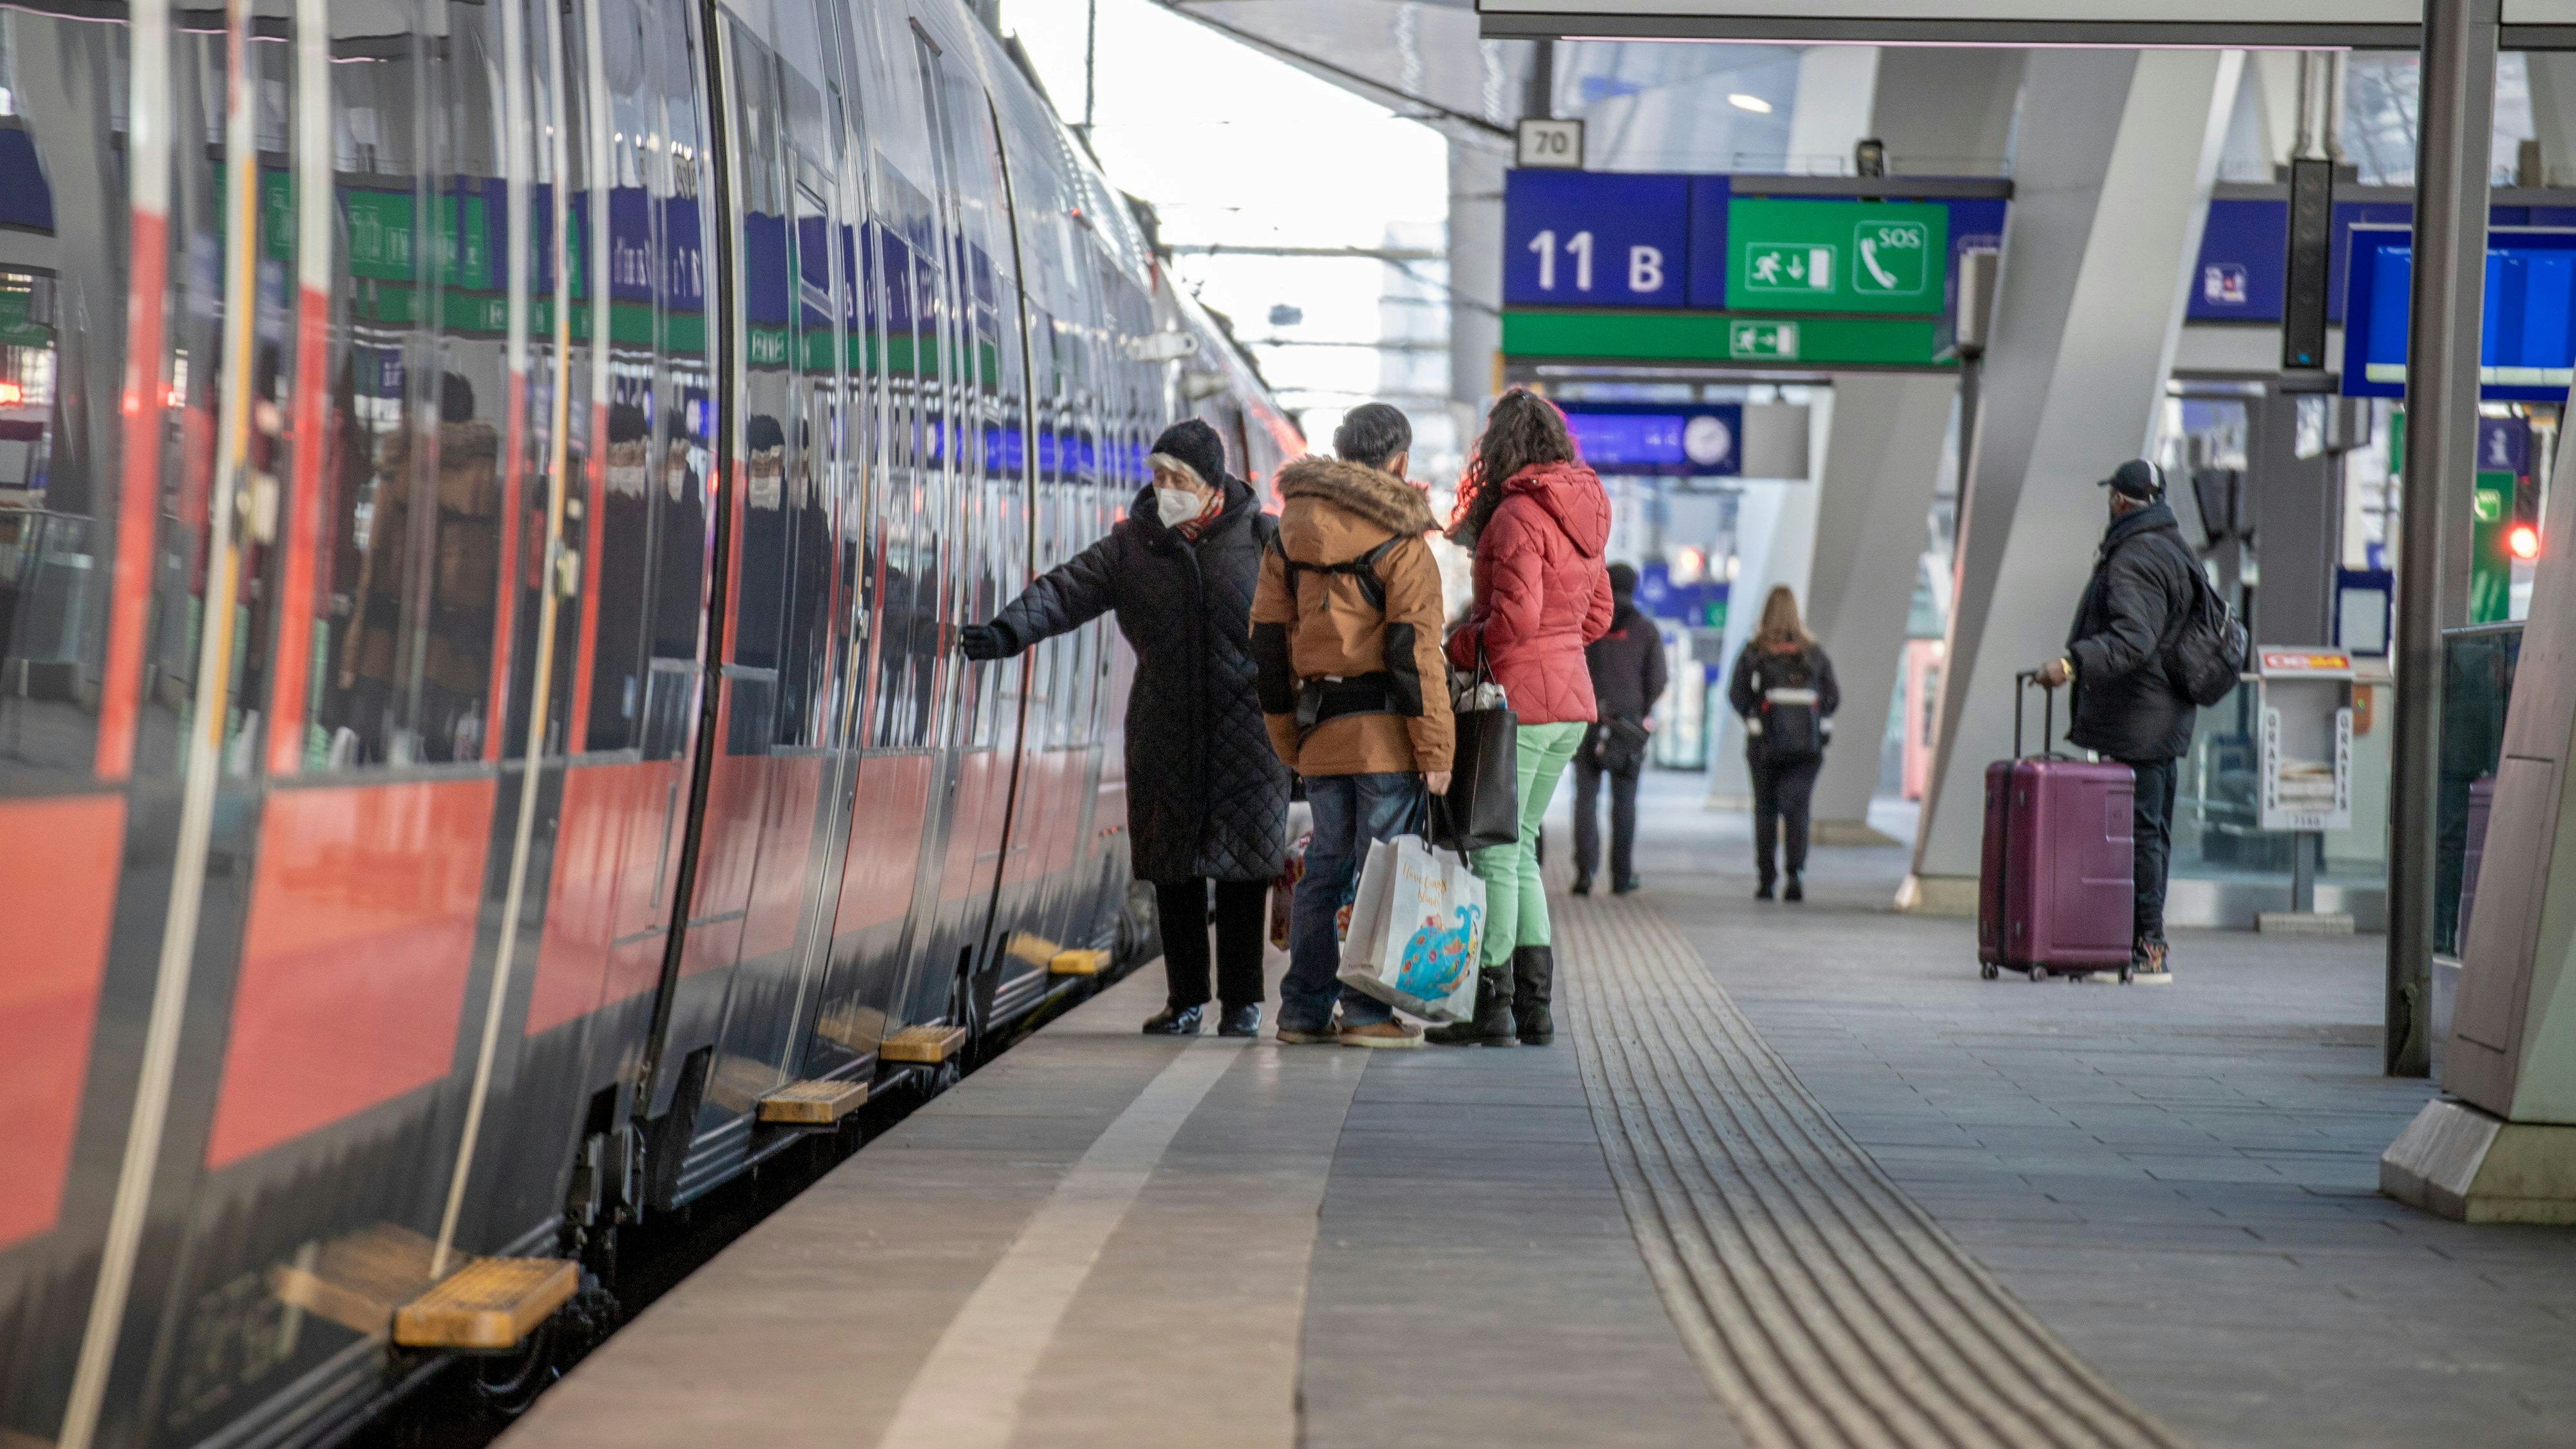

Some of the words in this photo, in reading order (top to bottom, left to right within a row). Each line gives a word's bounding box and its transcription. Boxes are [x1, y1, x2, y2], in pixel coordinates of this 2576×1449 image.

[1533, 131, 1568, 155] 70
[1527, 230, 1593, 290] 11
[1629, 245, 1664, 292] B
[1879, 227, 1921, 249] SOS
[2268, 714, 2276, 810] GRATIS
[2339, 714, 2348, 810] GRATIS
